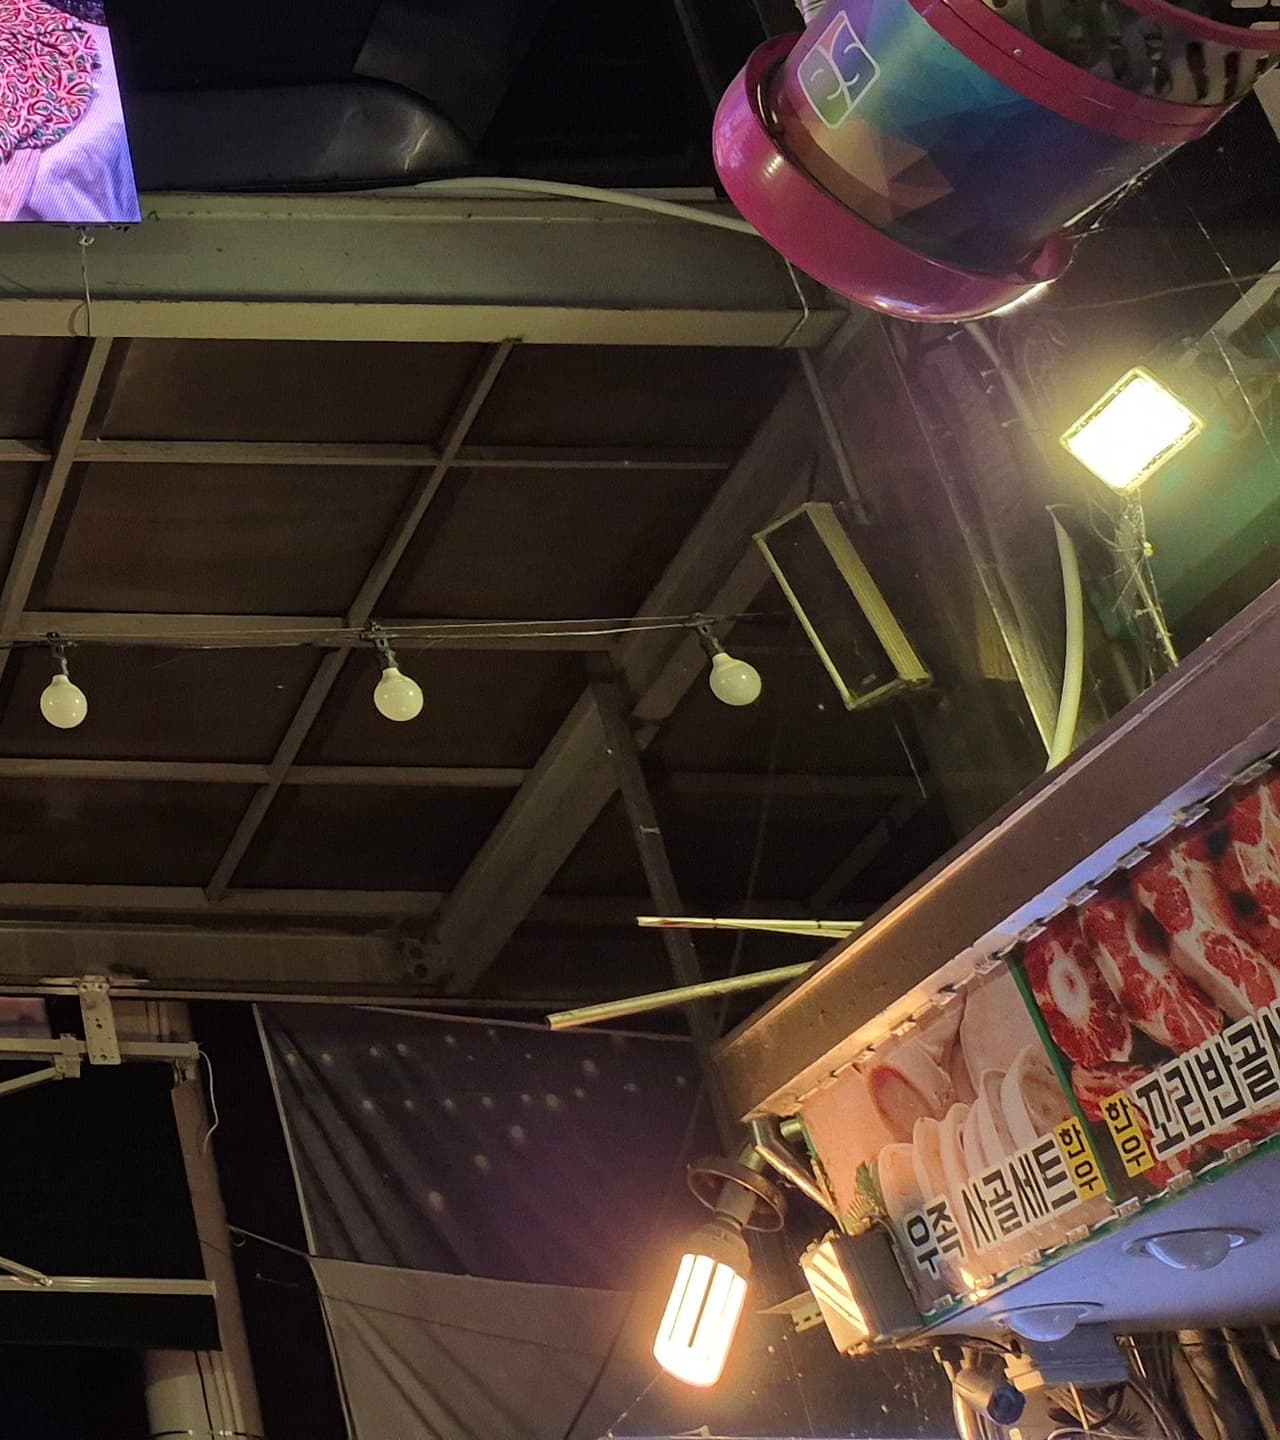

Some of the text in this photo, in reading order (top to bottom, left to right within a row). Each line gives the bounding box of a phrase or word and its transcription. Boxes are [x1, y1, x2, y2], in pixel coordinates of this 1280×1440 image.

[1058, 1123, 1101, 1193] 한우
[1104, 1096, 1149, 1168] 한우
[905, 1139, 1079, 1275] 우족 사골세트
